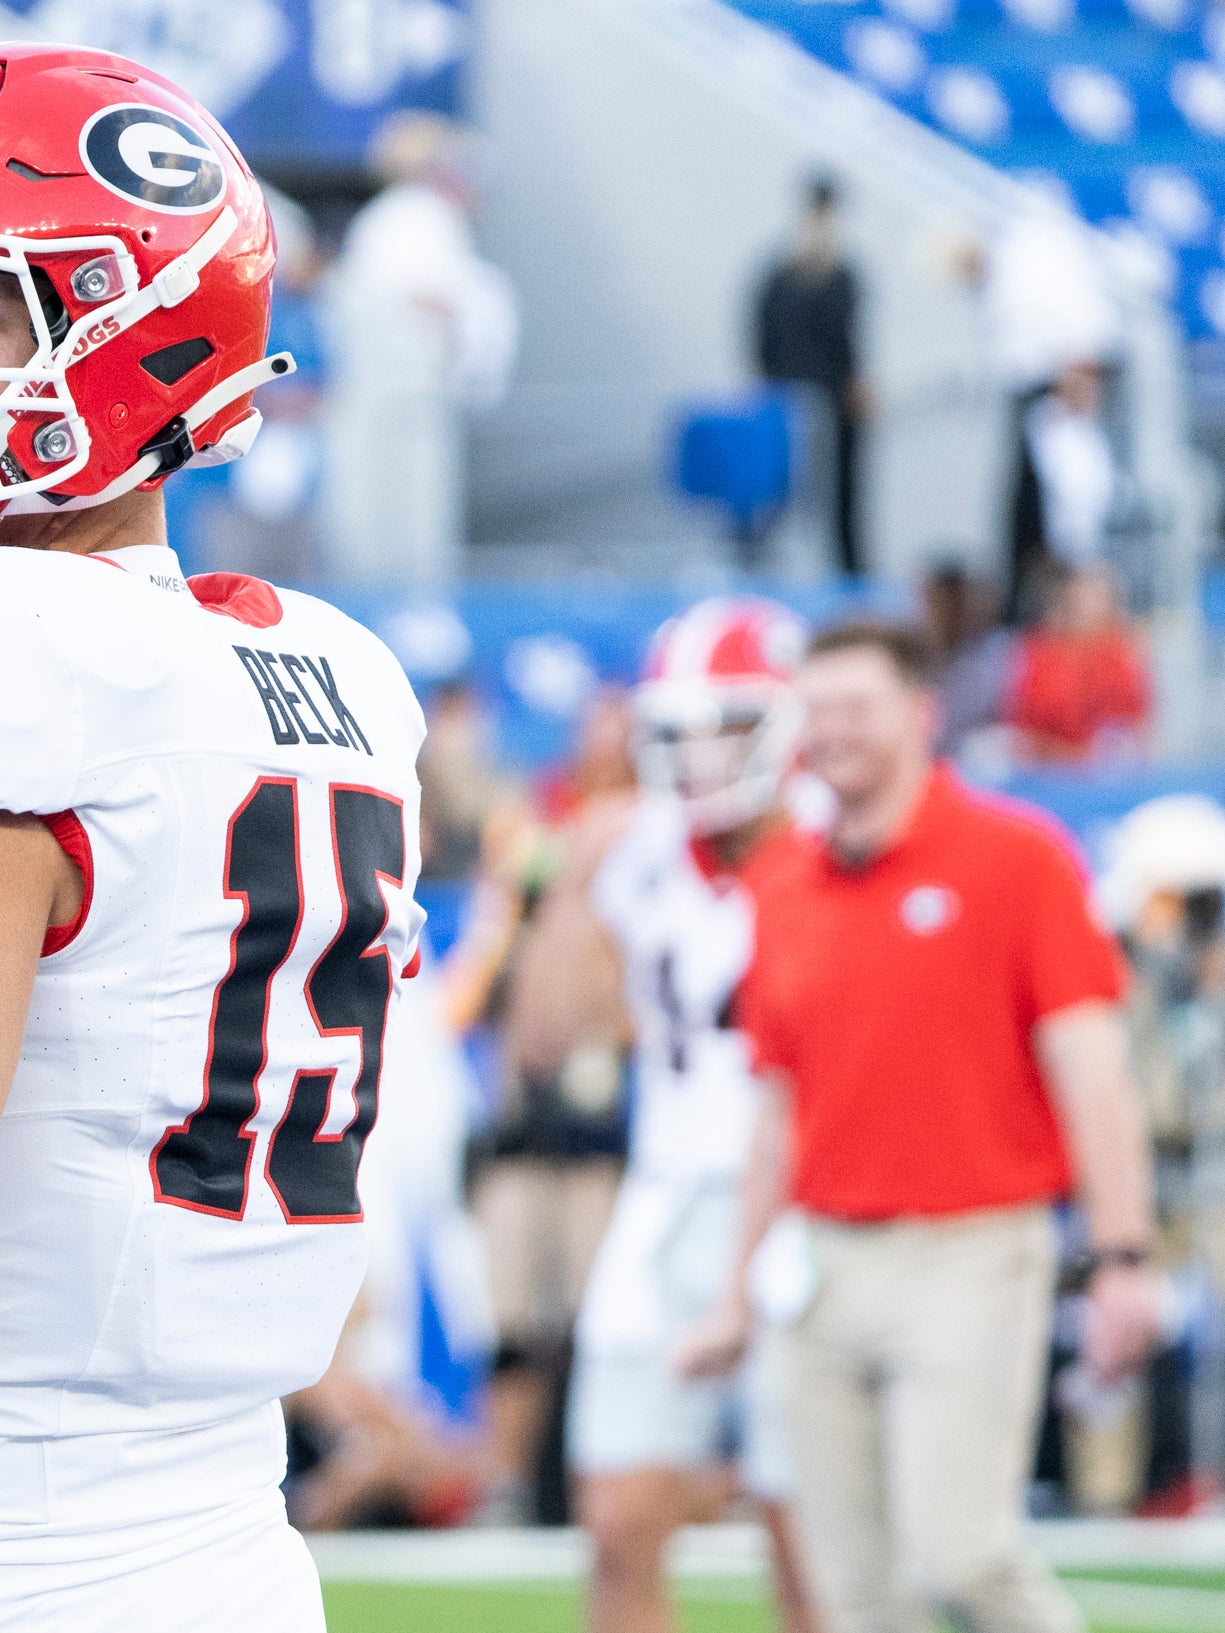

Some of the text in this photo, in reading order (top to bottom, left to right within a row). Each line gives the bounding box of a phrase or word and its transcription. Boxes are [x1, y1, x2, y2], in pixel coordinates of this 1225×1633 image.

[80, 104, 226, 214] G
[149, 574, 180, 592] NIKE
[231, 644, 374, 757] BECK
[148, 775, 405, 1225] 15
